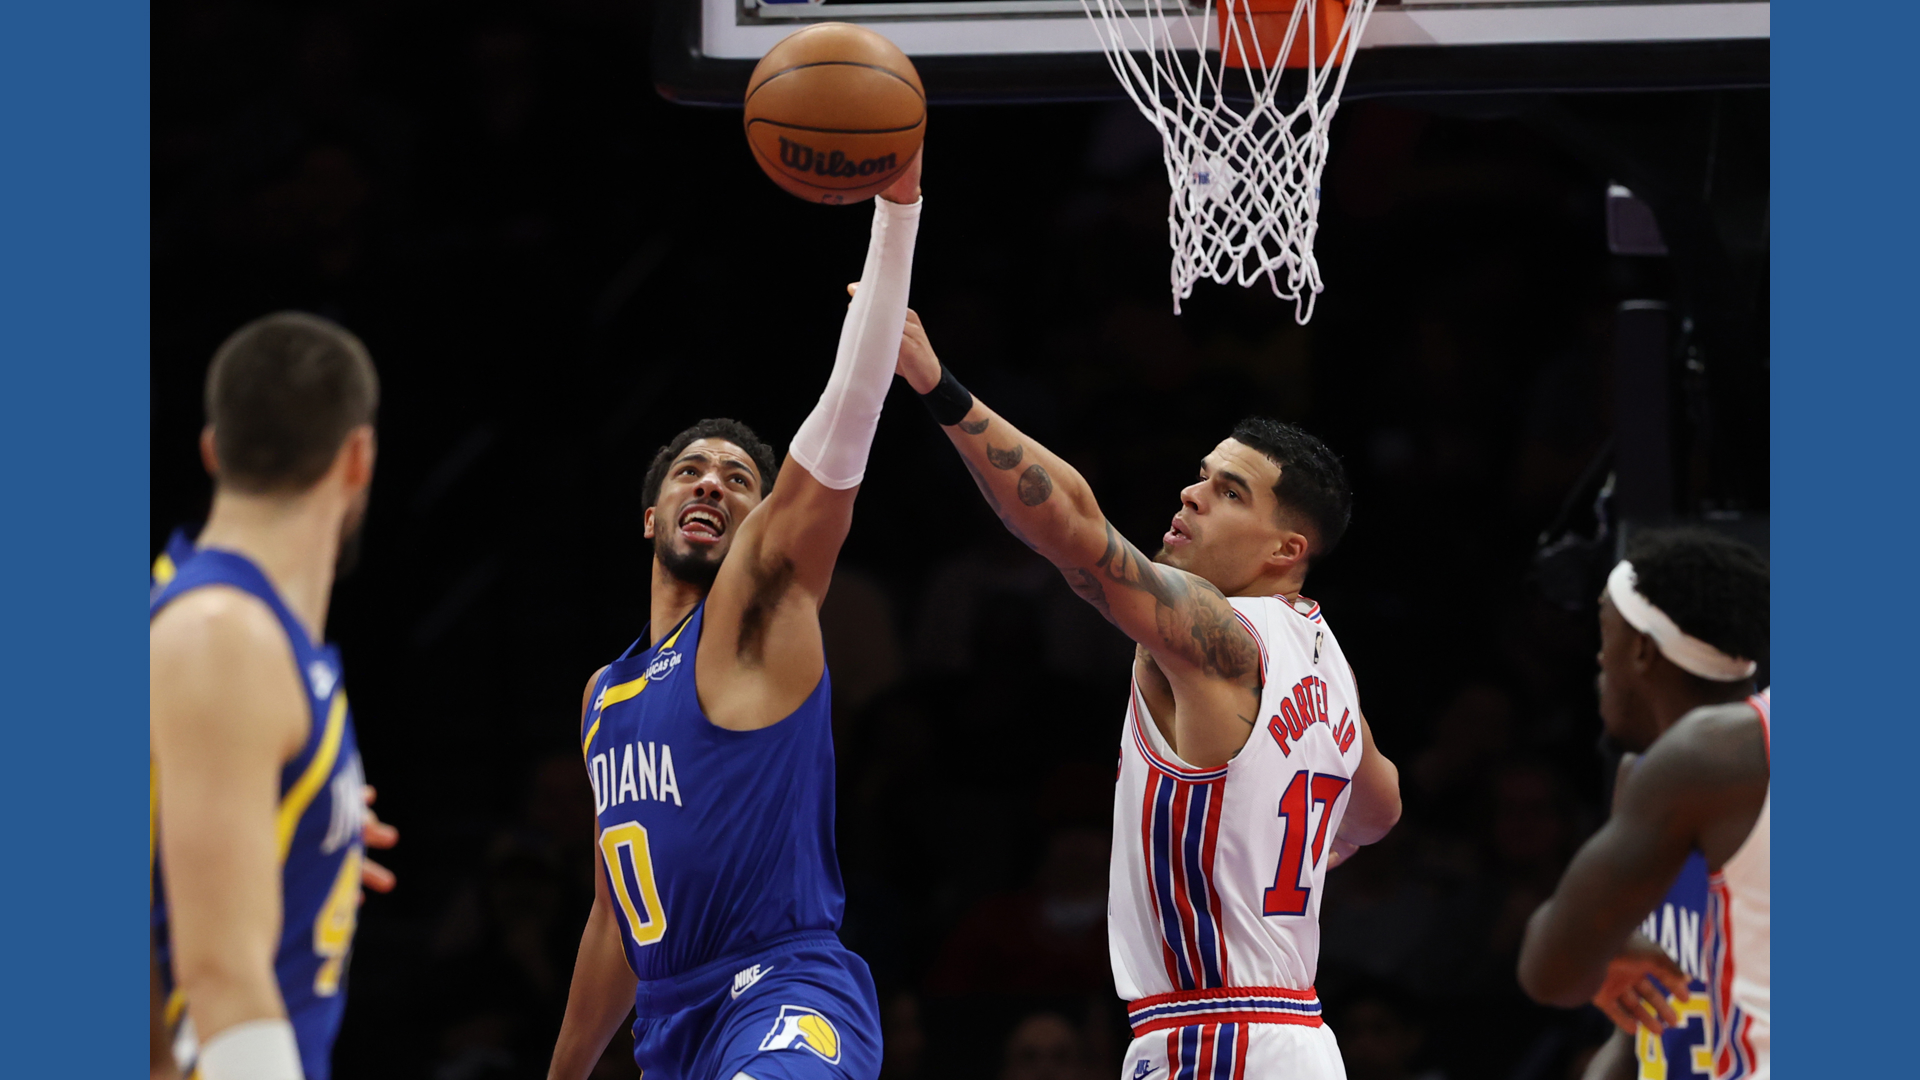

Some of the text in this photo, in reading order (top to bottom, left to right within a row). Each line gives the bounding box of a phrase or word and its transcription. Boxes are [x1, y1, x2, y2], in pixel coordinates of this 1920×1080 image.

[778, 135, 897, 179] Wilson
[645, 657, 669, 680] LUCAS
[589, 741, 683, 817] DIANA
[1262, 769, 1351, 917] 17
[599, 820, 668, 947] 0
[734, 963, 761, 991] NIKE
